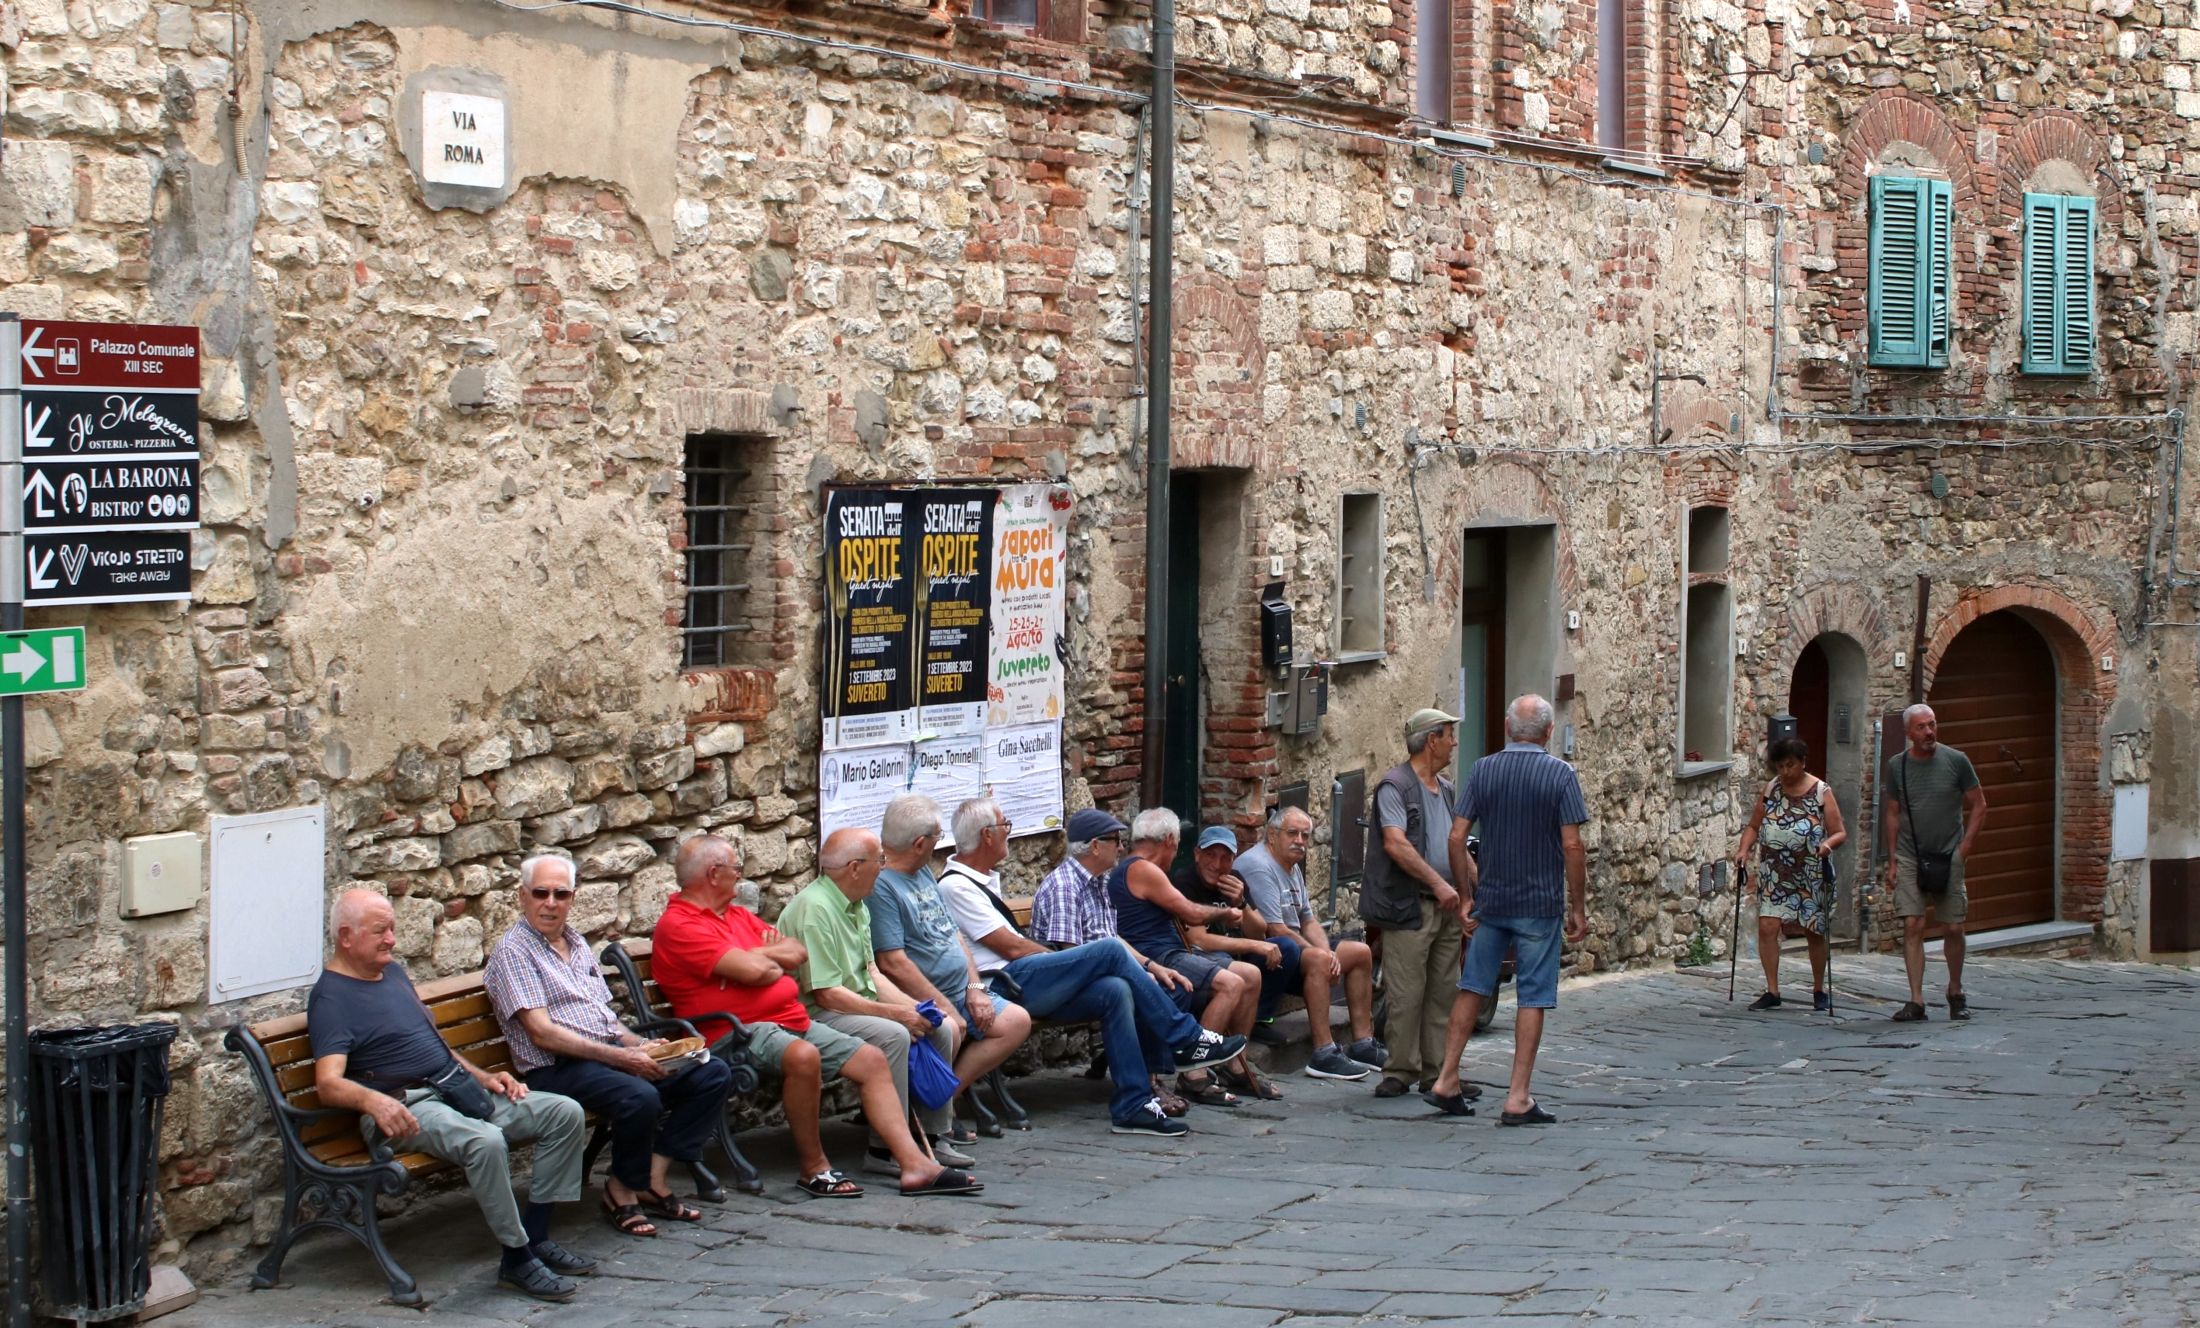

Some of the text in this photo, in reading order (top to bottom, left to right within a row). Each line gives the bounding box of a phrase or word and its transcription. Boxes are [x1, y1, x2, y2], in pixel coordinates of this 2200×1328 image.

[453, 111, 476, 130] VIA
[445, 144, 484, 165] ROMA
[91, 339, 195, 357] Palazzo Comunale
[124, 360, 164, 374] XIII SEC
[100, 395, 196, 445] Melograno
[90, 467, 192, 489] LA BARONA
[840, 506, 885, 537] SERATA
[923, 503, 965, 533] SERATA
[840, 538, 902, 583] OSPITE
[922, 534, 979, 577] OSPITE
[1007, 628, 1043, 650] Agosto
[853, 669, 883, 684] SETTEMBRE
[883, 668, 897, 681] 2023
[931, 661, 959, 674] SETTEMBRE
[959, 660, 973, 673] 2023
[847, 682, 887, 704] SUVERETO
[926, 674, 963, 694] SUVERETO
[998, 732, 1052, 758] Gina Sacchelli
[842, 756, 904, 783] Mario Gallorini
[921, 747, 979, 770] Diego Toninelli
